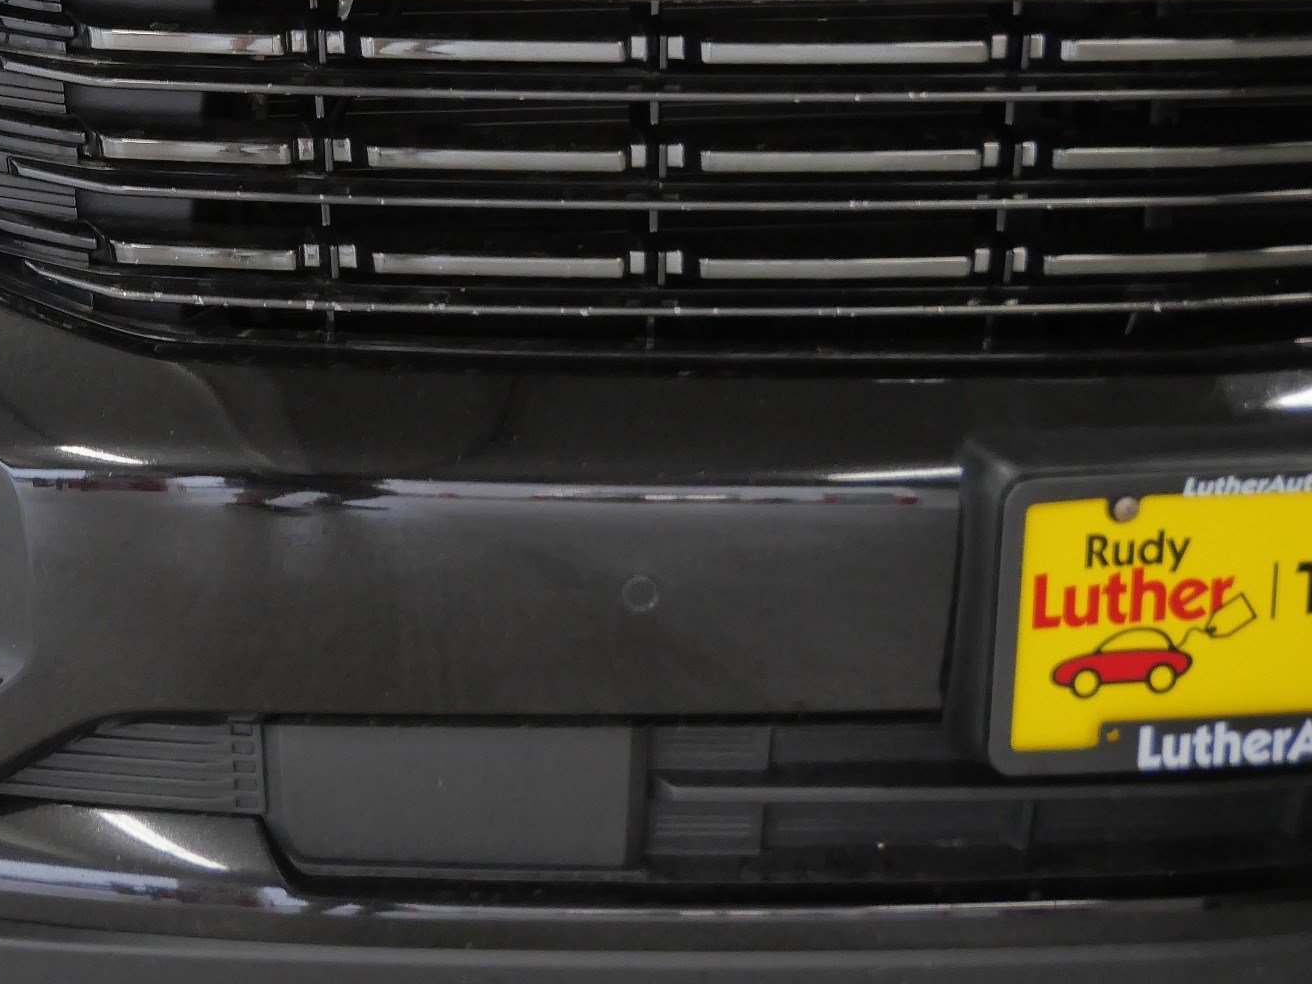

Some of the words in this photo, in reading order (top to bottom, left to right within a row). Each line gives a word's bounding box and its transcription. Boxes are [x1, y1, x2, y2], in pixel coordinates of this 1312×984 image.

[1084, 529, 1192, 573] Rudy
[1032, 567, 1235, 630] Luther
[1138, 718, 1312, 771] LutherA
